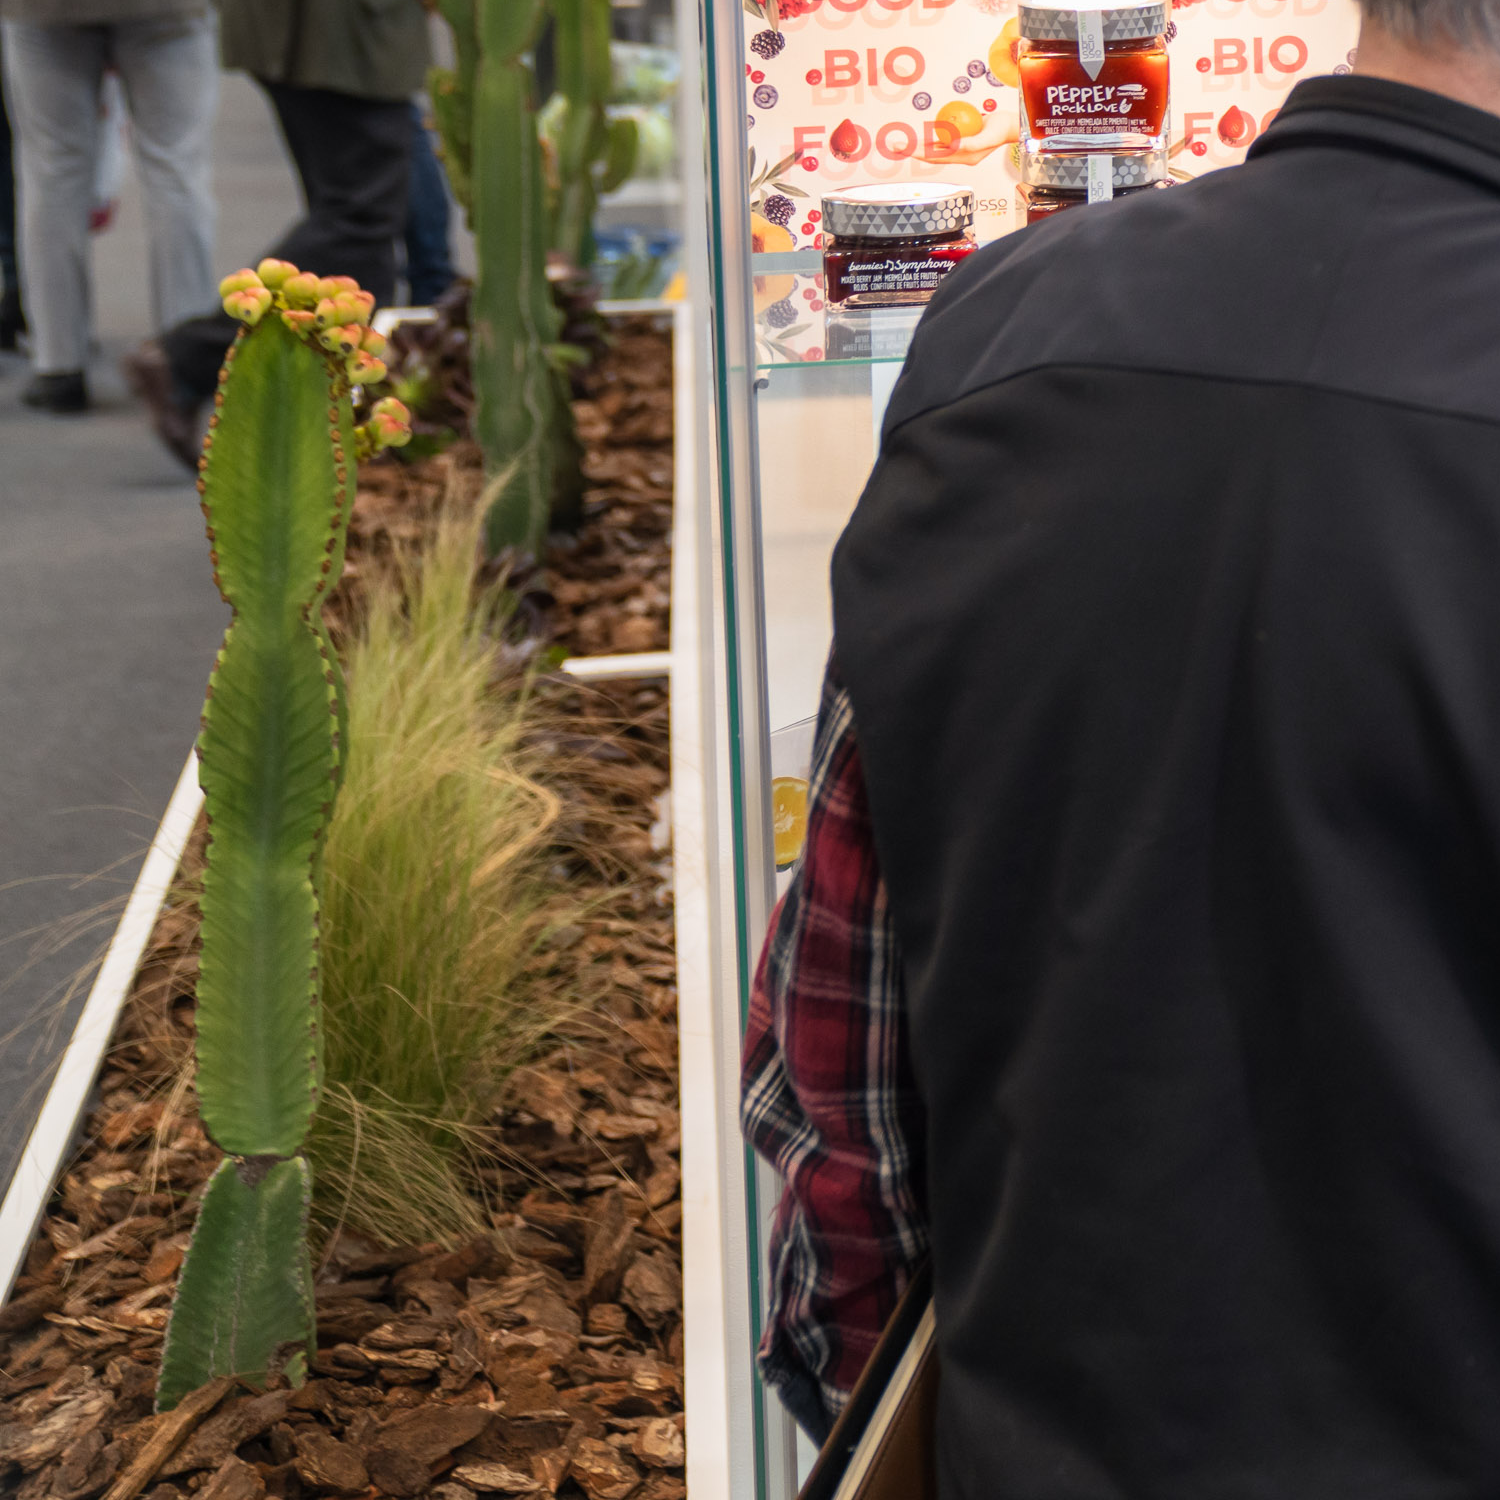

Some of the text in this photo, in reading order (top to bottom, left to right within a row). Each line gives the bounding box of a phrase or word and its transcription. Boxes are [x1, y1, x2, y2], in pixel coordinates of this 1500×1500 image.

[1213, 35, 1309, 75] BIO
[824, 46, 926, 88] BIO
[1050, 118, 1067, 127] PEPPER
[1077, 118, 1103, 127] MERMELADA
[793, 120, 961, 164] FOOD
[894, 257, 956, 274] Symphony
[841, 276, 856, 284] MIXED
[856, 275, 872, 283] BERRY
[884, 273, 913, 282] MERMELADA
[920, 271, 938, 280] FRUTOS
[853, 283, 869, 292] ROJOS
[870, 282, 896, 291] CONFITURE
[903, 281, 920, 289] FRUITS
[920, 280, 938, 289] ROUGES
